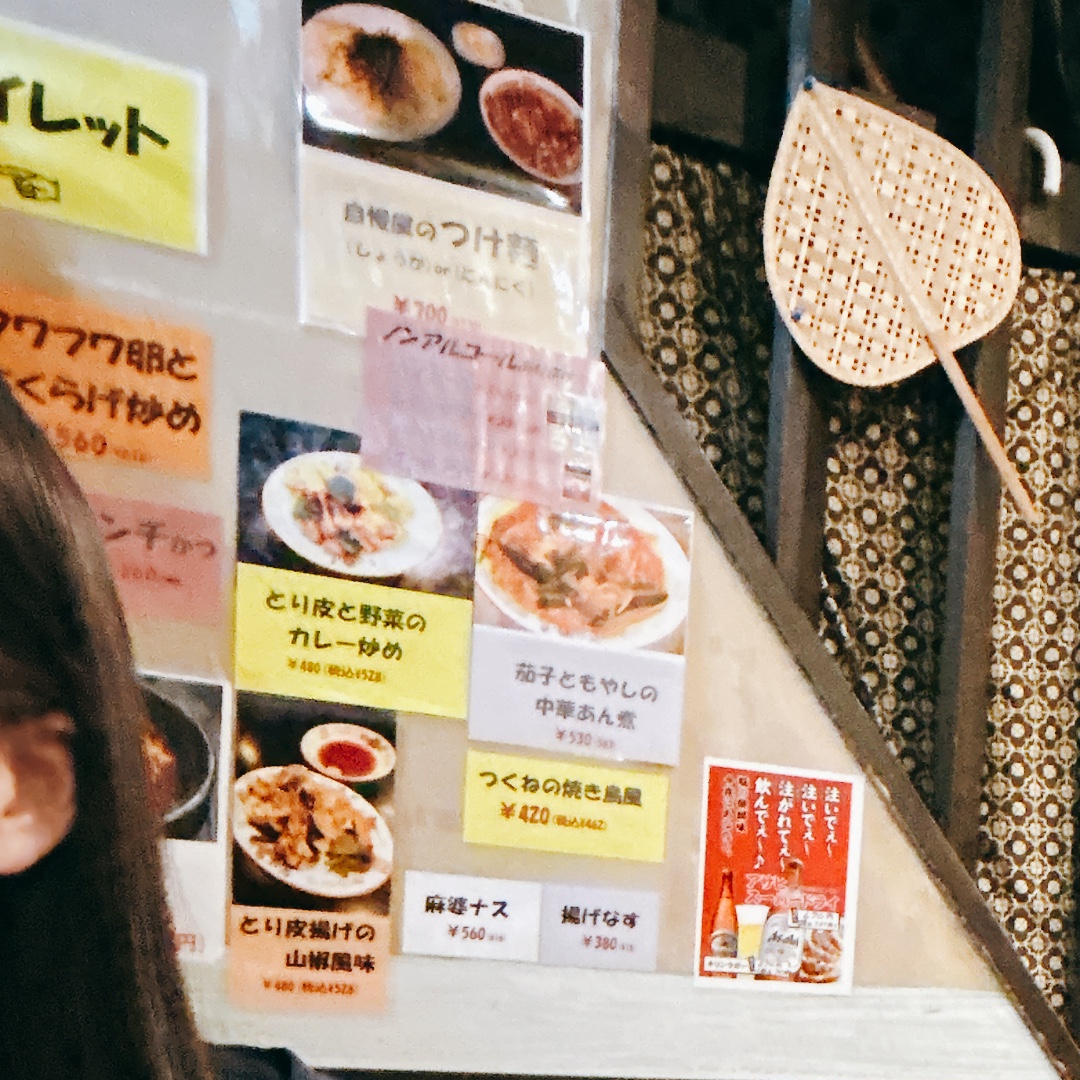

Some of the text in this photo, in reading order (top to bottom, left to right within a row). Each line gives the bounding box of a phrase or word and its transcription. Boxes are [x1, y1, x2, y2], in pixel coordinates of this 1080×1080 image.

[266, 590, 427, 633] とり皮と野菜の
[288, 627, 404, 661] カレー炒め
[514, 662, 660, 703] 茄子ともやしの
[535, 698, 637, 730] 中華あん煮
[425, 894, 510, 919] 麻婆ナス
[561, 904, 641, 928] 揚げなす
[239, 915, 376, 942] とり皮揚げの
[285, 949, 376, 974] 山椒風味
